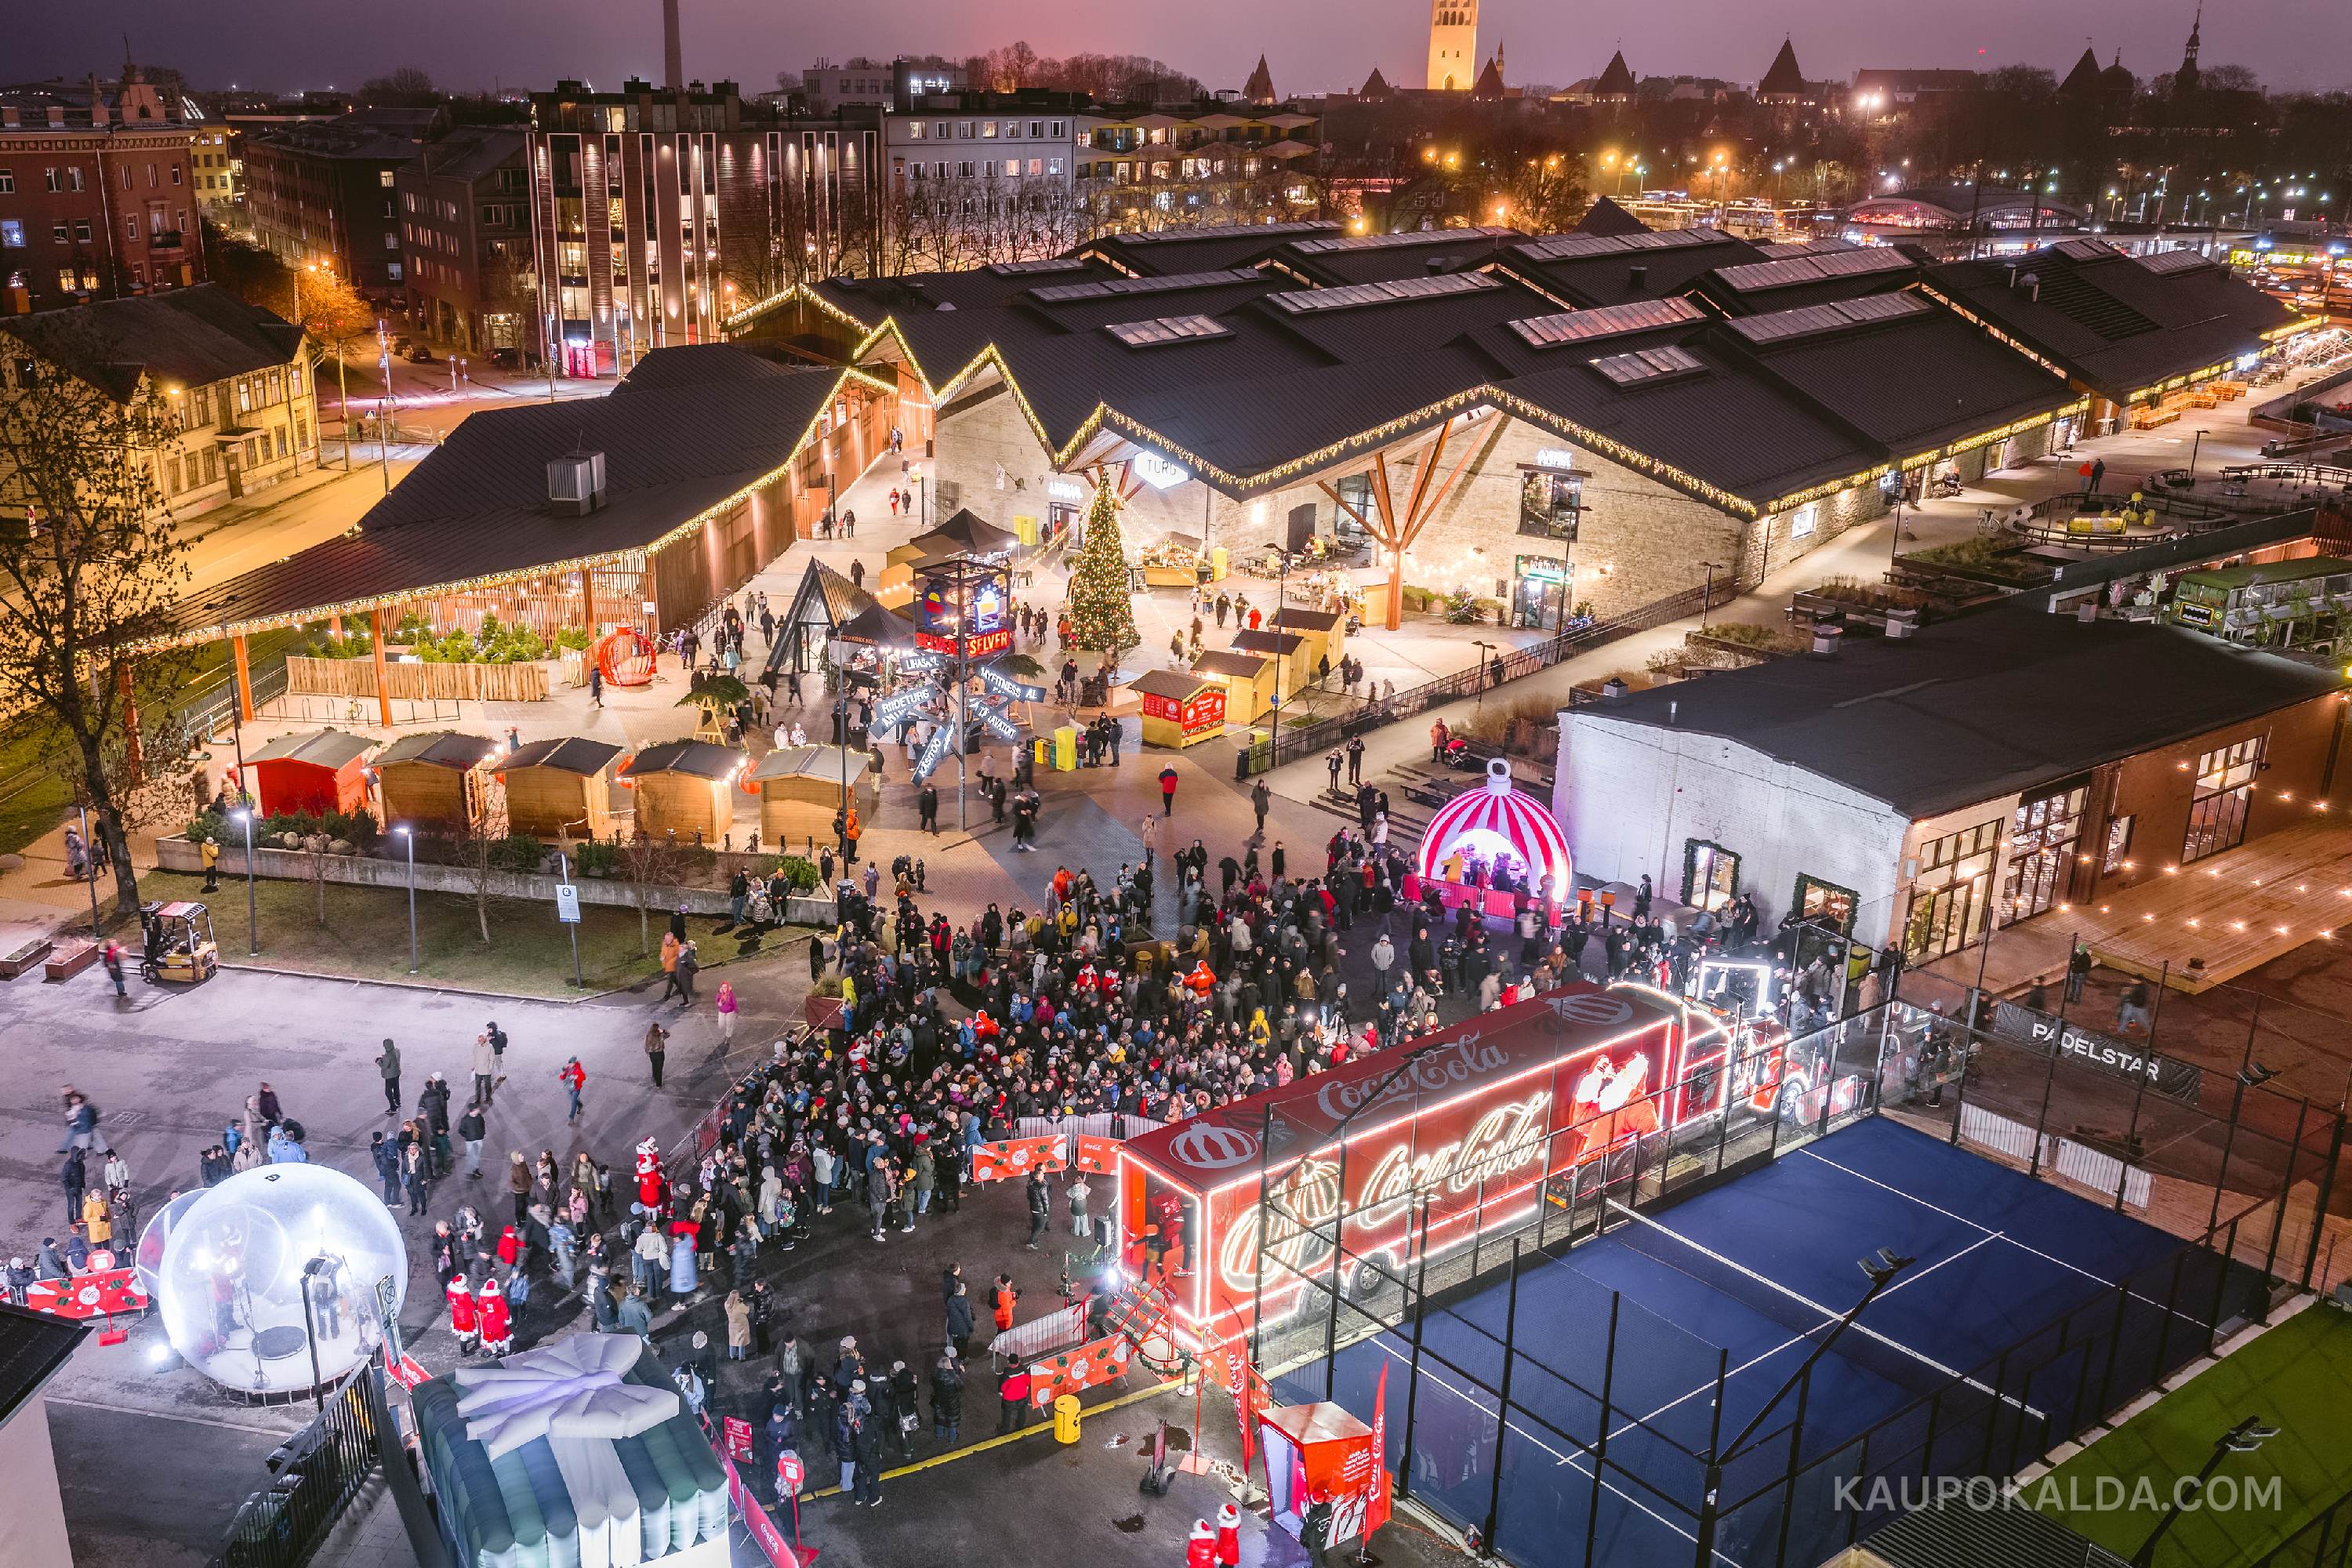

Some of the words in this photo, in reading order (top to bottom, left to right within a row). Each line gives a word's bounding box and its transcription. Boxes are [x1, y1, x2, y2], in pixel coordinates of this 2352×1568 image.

[1148, 459, 1177, 476] TURG
[969, 630, 1008, 655] SELVER
[981, 667, 1022, 698] MYFITNESS
[881, 688, 930, 713] RIIDETURG
